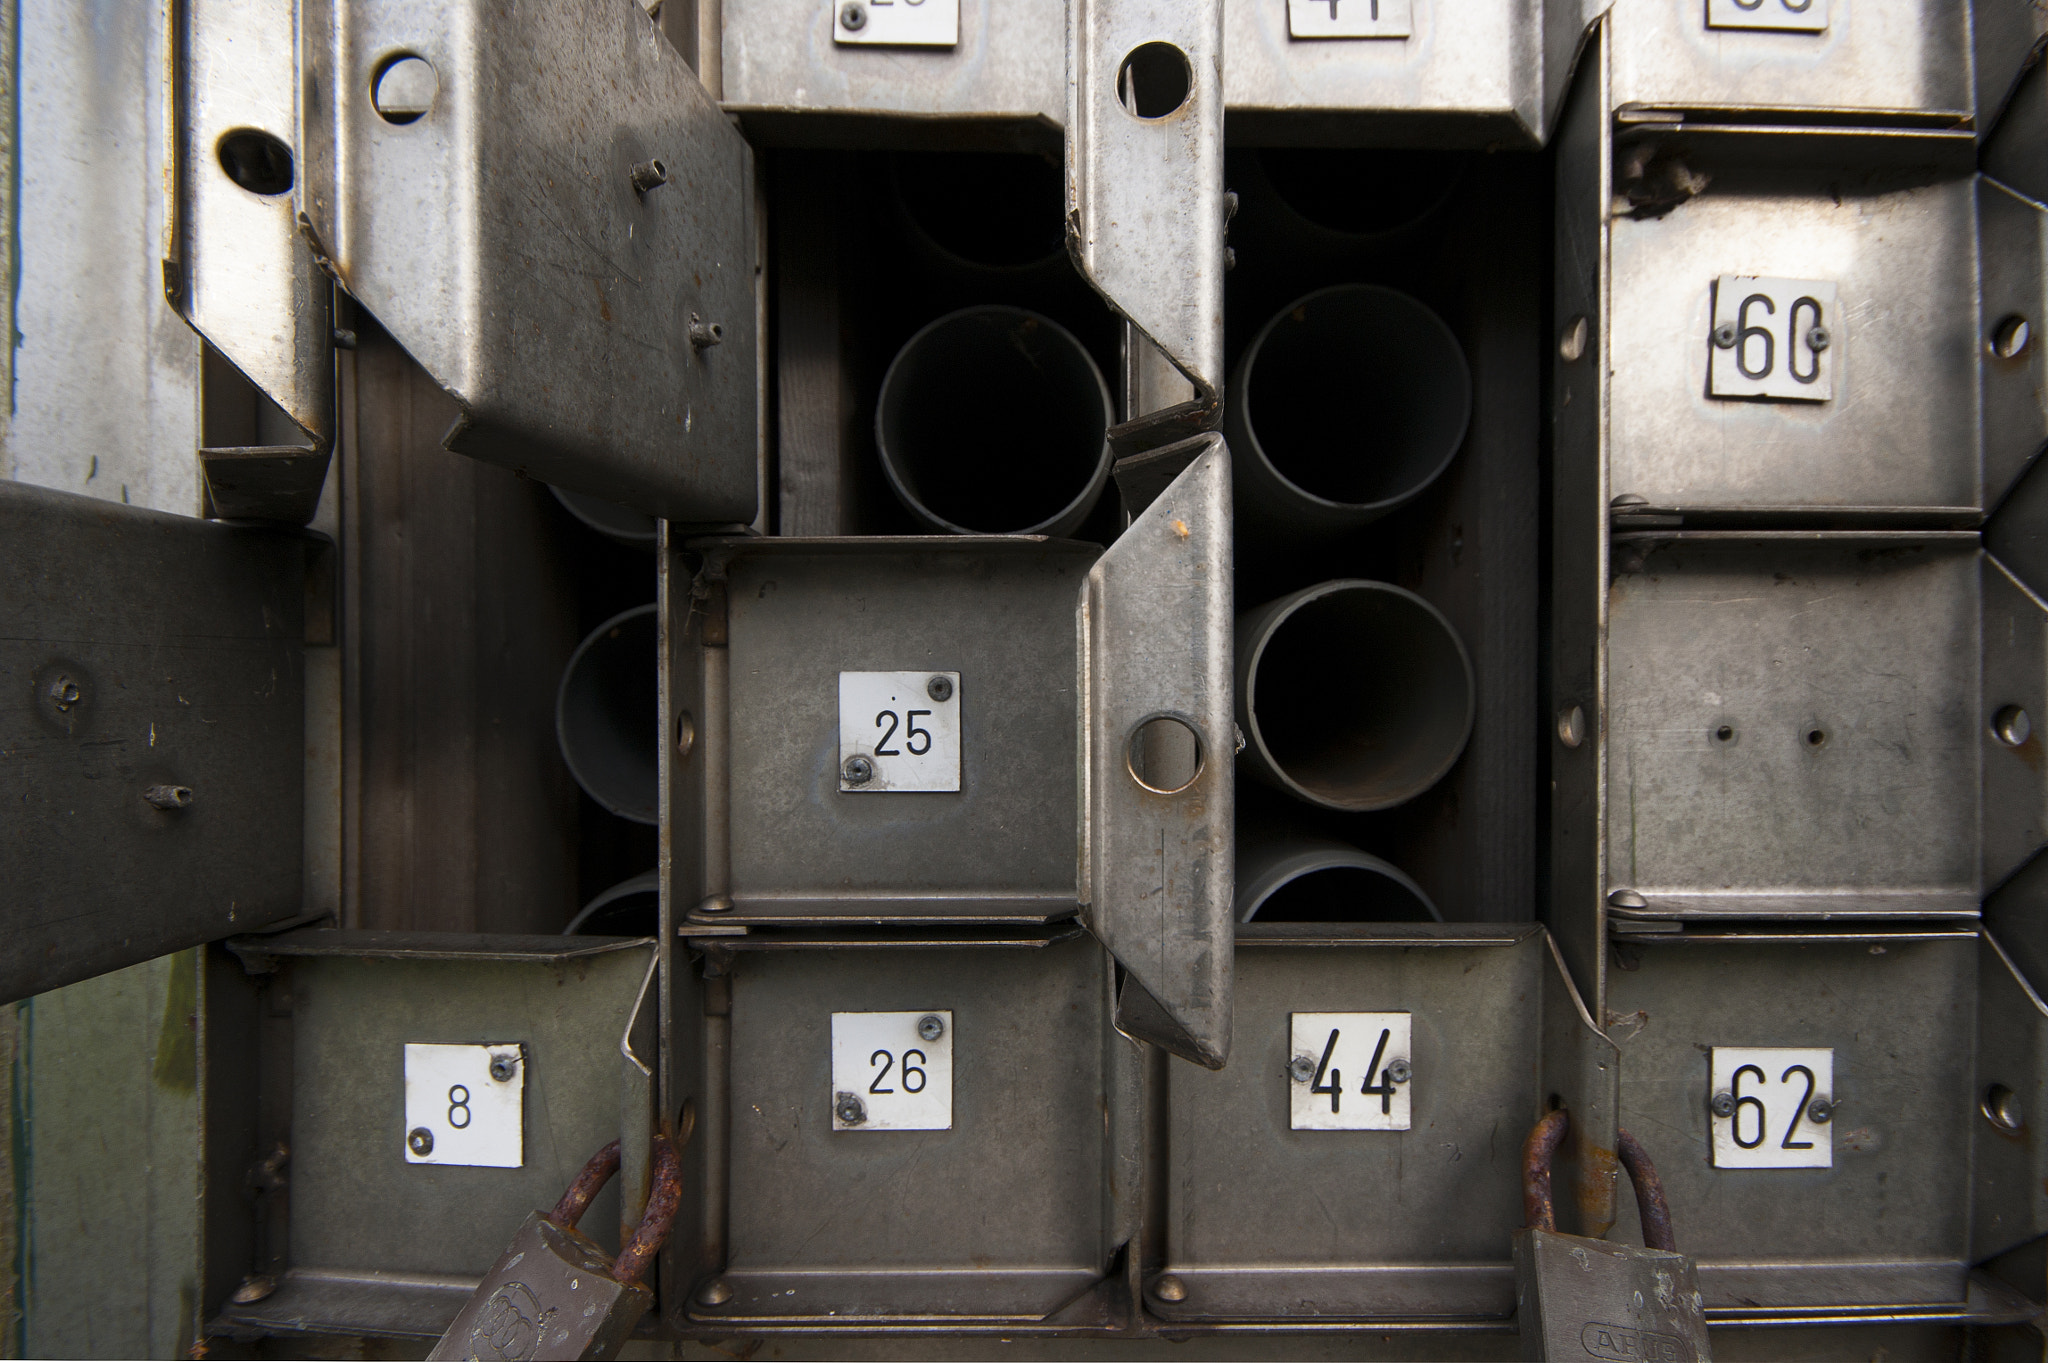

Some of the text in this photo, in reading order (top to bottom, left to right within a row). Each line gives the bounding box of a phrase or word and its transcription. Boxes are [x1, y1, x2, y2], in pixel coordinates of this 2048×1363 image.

[1735, 293, 1822, 384] 60
[874, 709, 932, 757] 25
[869, 1049, 927, 1095] 26
[1310, 1028, 1396, 1115] 44
[448, 1084, 471, 1129] 8
[1731, 1064, 1817, 1150] 62
